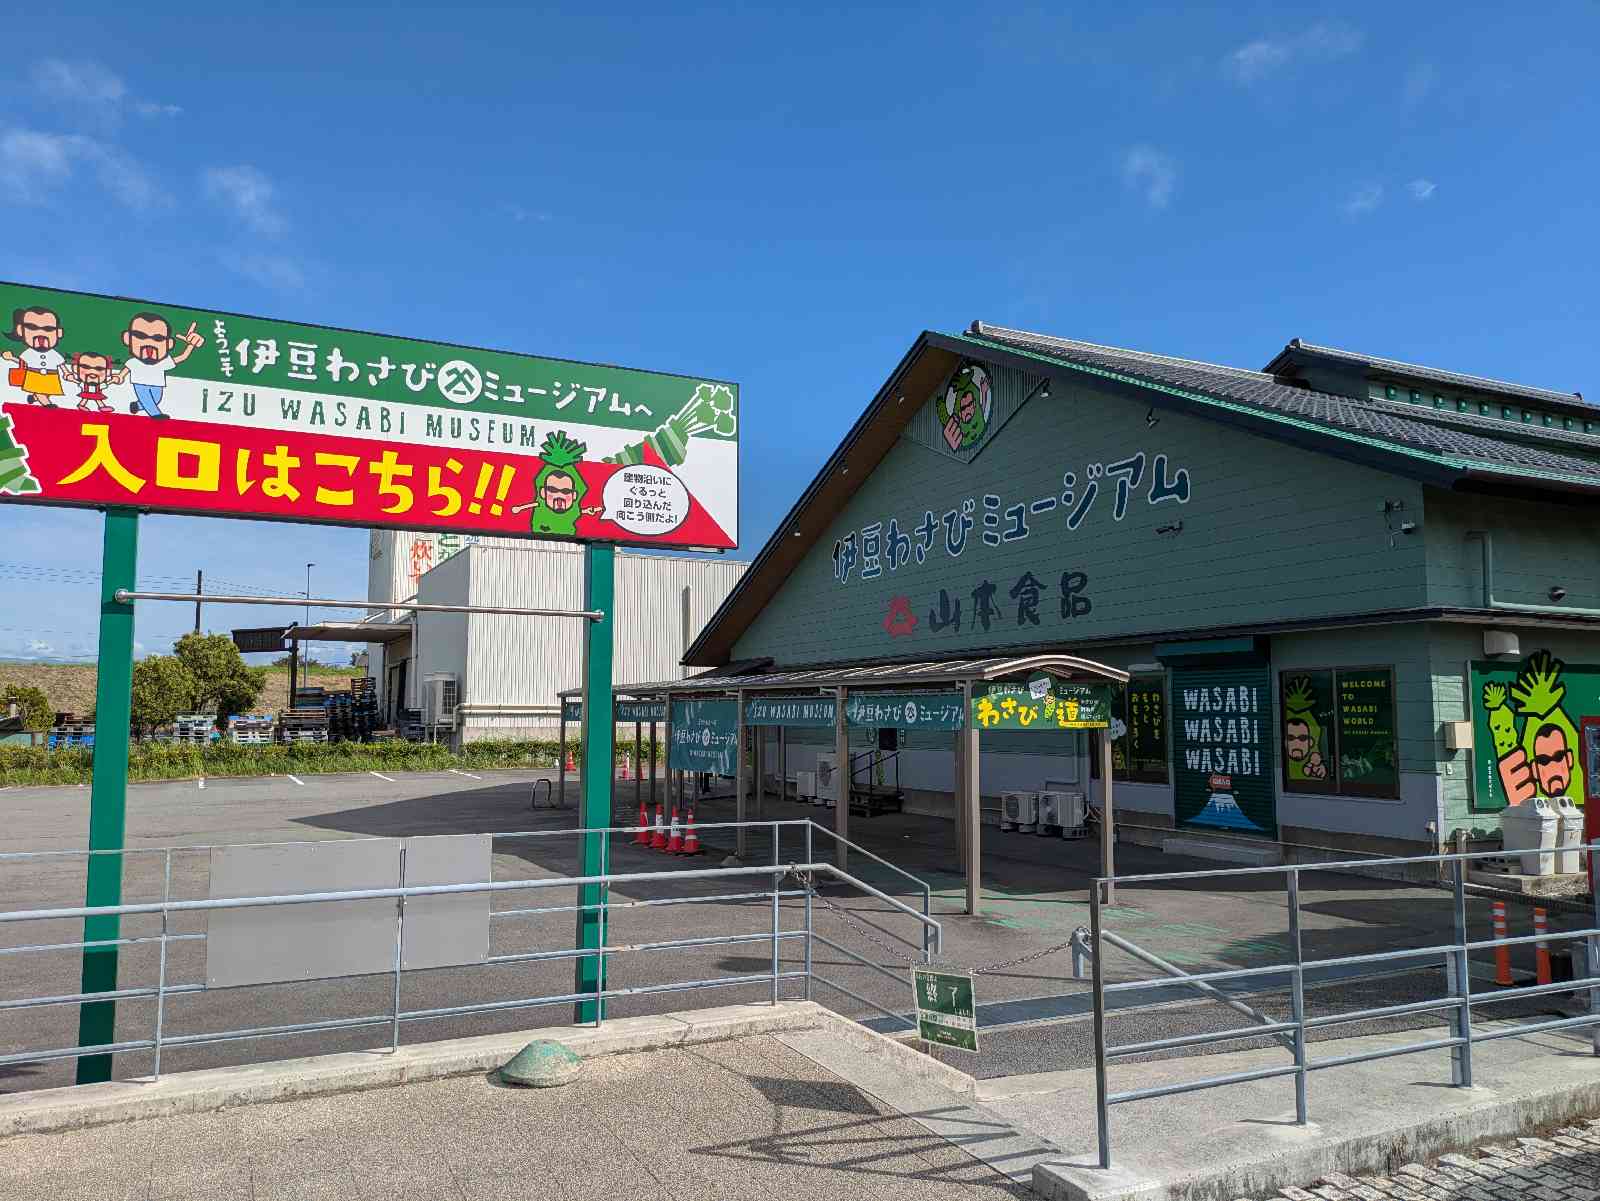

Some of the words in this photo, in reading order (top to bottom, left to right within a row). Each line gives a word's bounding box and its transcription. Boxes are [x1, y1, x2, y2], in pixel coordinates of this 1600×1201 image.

[213, 319, 235, 378] ようこそ
[201, 387, 257, 417] IZU
[280, 397, 406, 435] WASABI
[426, 412, 539, 448] MUSEUM
[55, 423, 517, 517] 入口はこちら!!
[623, 472, 672, 486] 建物沿いに
[623, 497, 672, 512] 回り込んだ
[629, 485, 667, 499] ぐるっと
[832, 451, 1191, 584] 伊豆わさびミュージアム
[928, 570, 1093, 633] 山本食品
[1342, 679, 1386, 689] WELCOME
[1342, 692, 1355, 701] TO
[976, 696, 1038, 729] わさび
[1055, 696, 1081, 725] 道
[1183, 685, 1258, 713] WASABI
[1343, 704, 1378, 714] WASABI
[1184, 716, 1259, 745] WASABI
[1343, 716, 1374, 726] WORLD
[1185, 746, 1260, 776] WASABI
